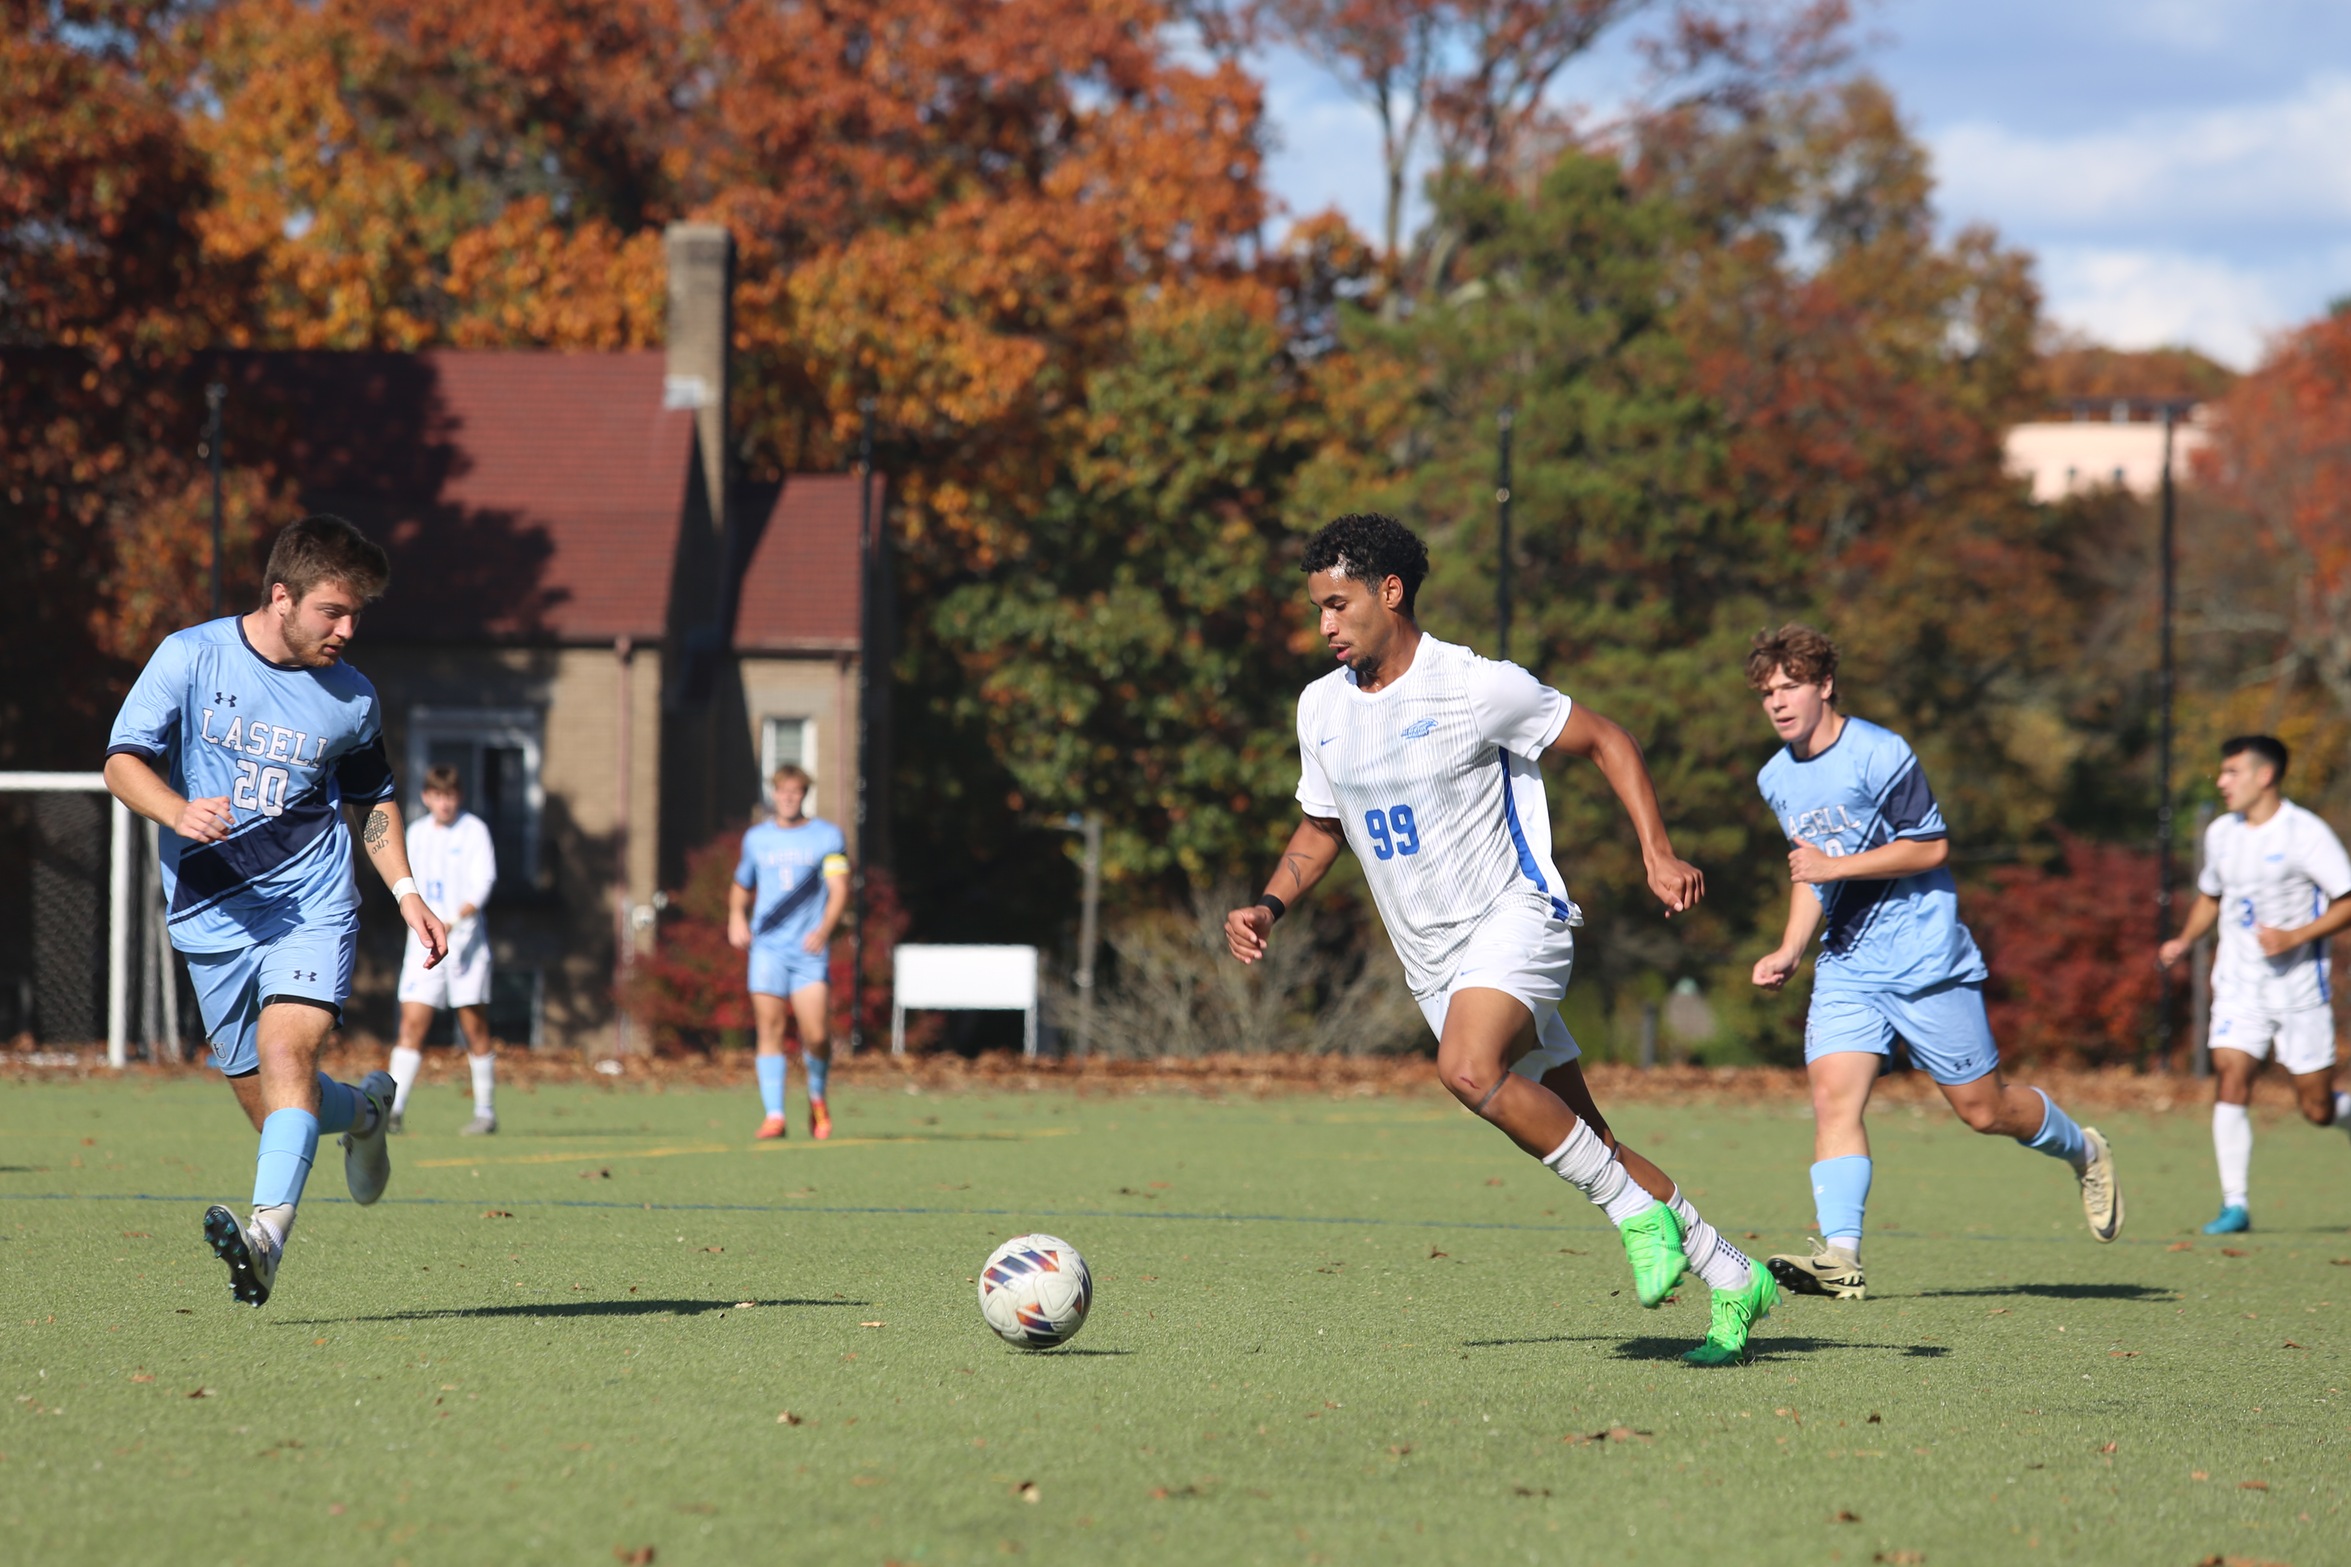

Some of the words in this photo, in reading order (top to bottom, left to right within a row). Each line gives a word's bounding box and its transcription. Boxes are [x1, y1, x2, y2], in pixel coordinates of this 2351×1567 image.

[201, 708, 328, 768] LASELL
[232, 758, 289, 817] 20
[1365, 804, 1420, 861] 99
[1786, 804, 1862, 840] ASELL
[2239, 897, 2255, 928] 3
